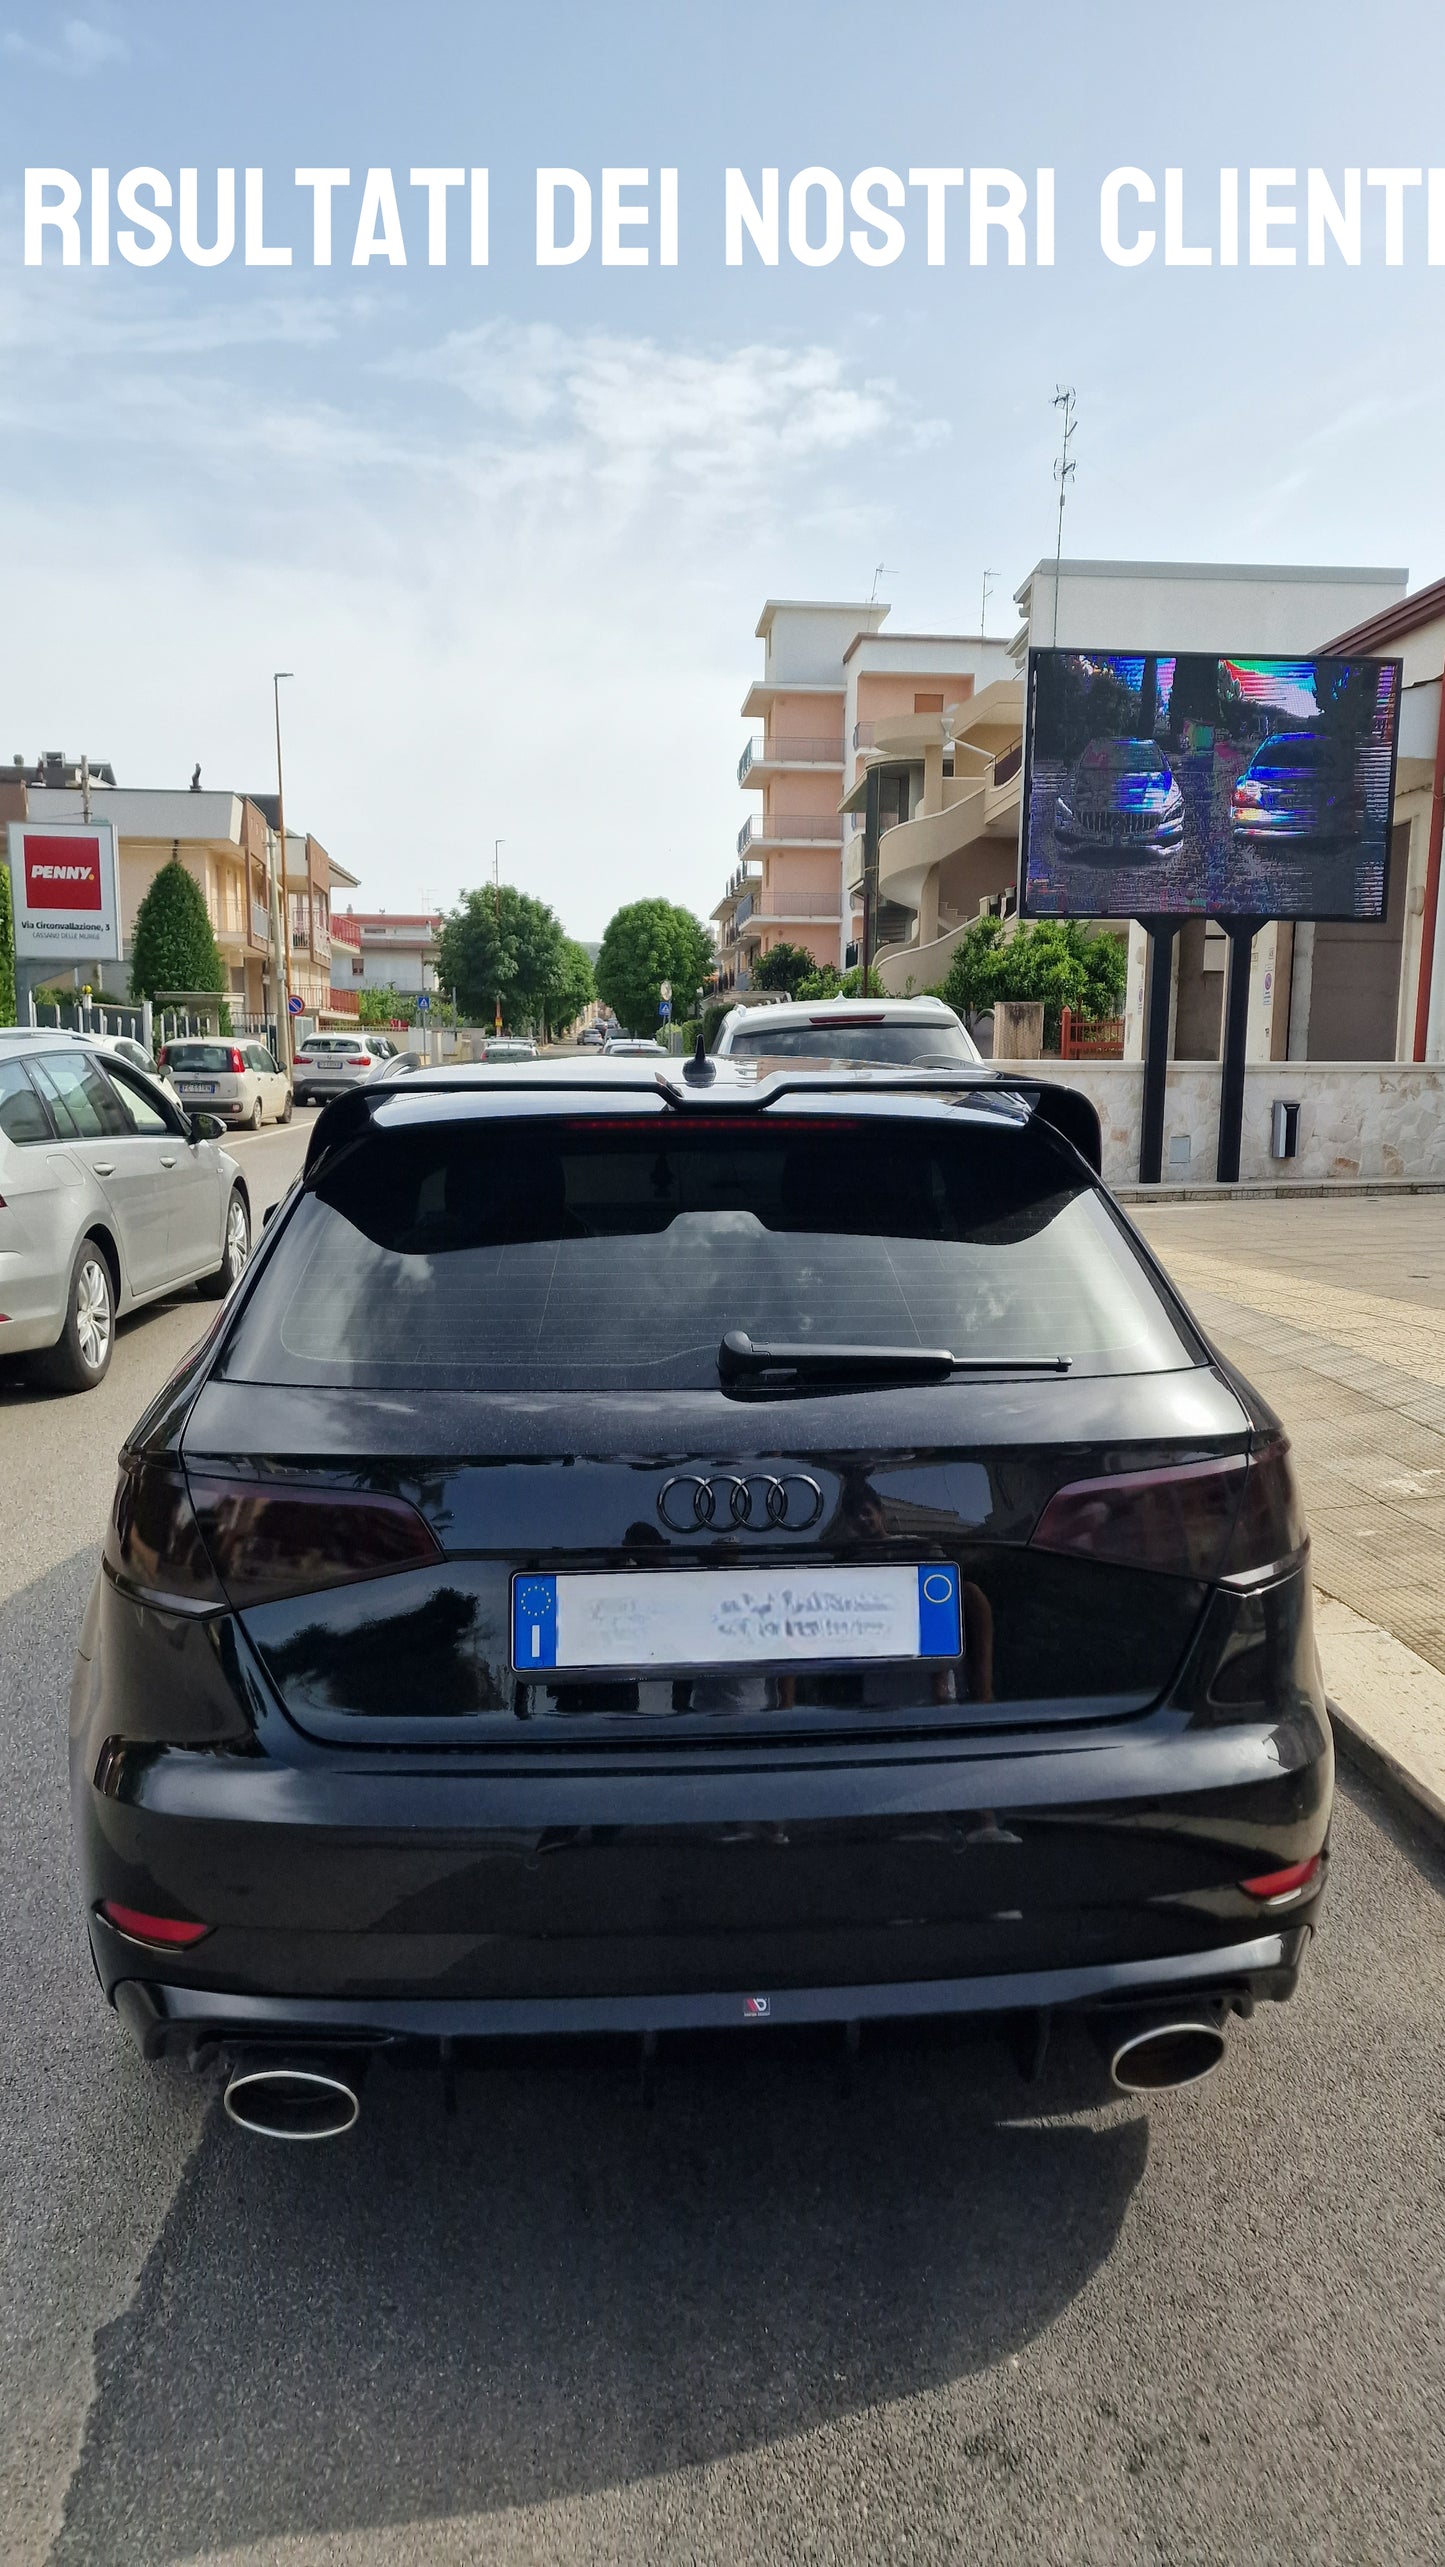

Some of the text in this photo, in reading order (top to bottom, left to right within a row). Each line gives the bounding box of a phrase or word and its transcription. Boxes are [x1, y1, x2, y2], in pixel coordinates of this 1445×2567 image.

[21, 920, 111, 932] Via Circonvallazione, 3
[32, 931, 60, 939] CASSANO
[61, 932, 77, 940] DELLE
